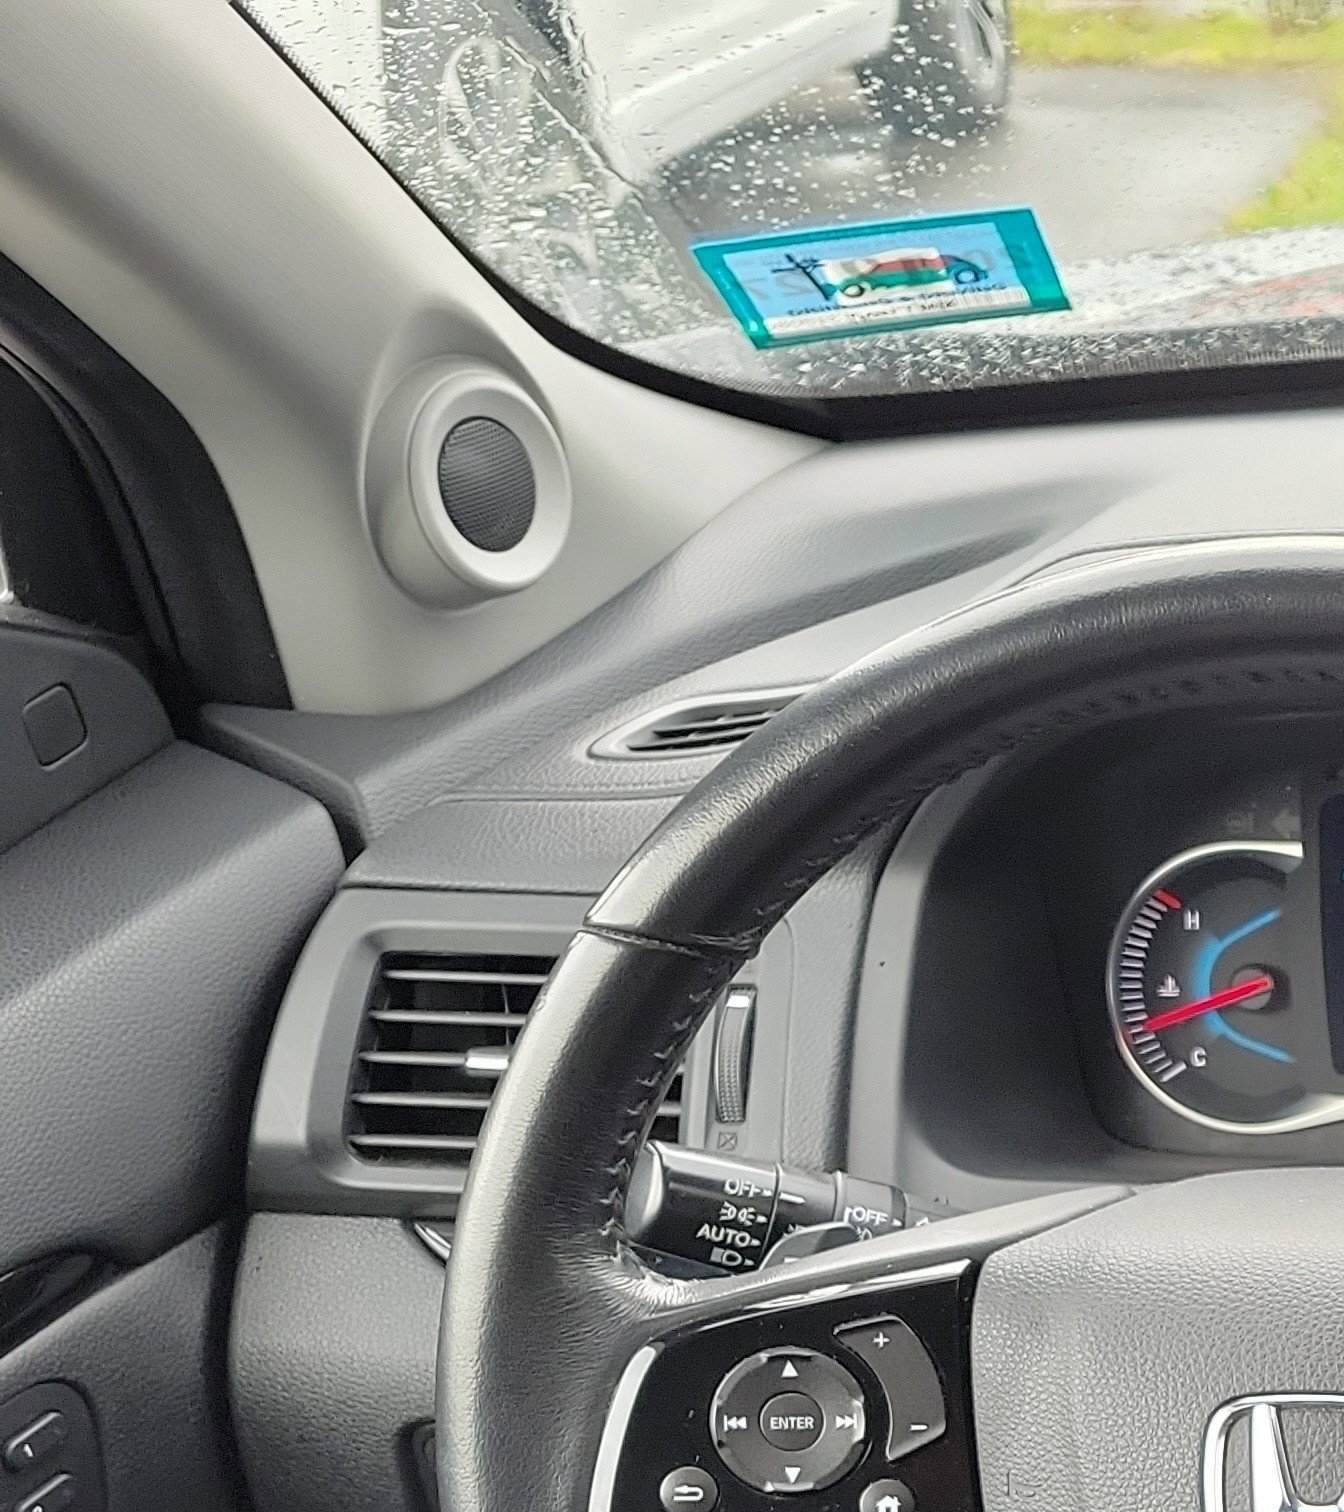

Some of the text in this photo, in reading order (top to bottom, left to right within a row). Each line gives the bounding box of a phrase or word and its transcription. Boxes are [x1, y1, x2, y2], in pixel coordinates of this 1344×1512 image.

[1184, 909, 1200, 931] H
[1190, 1046, 1207, 1067] C
[724, 1178, 760, 1197] OFF
[853, 1206, 888, 1226] OFF
[696, 1222, 751, 1247] AUTO
[769, 1416, 815, 1431] ENTER
[24, 1444, 33, 1457] 1
